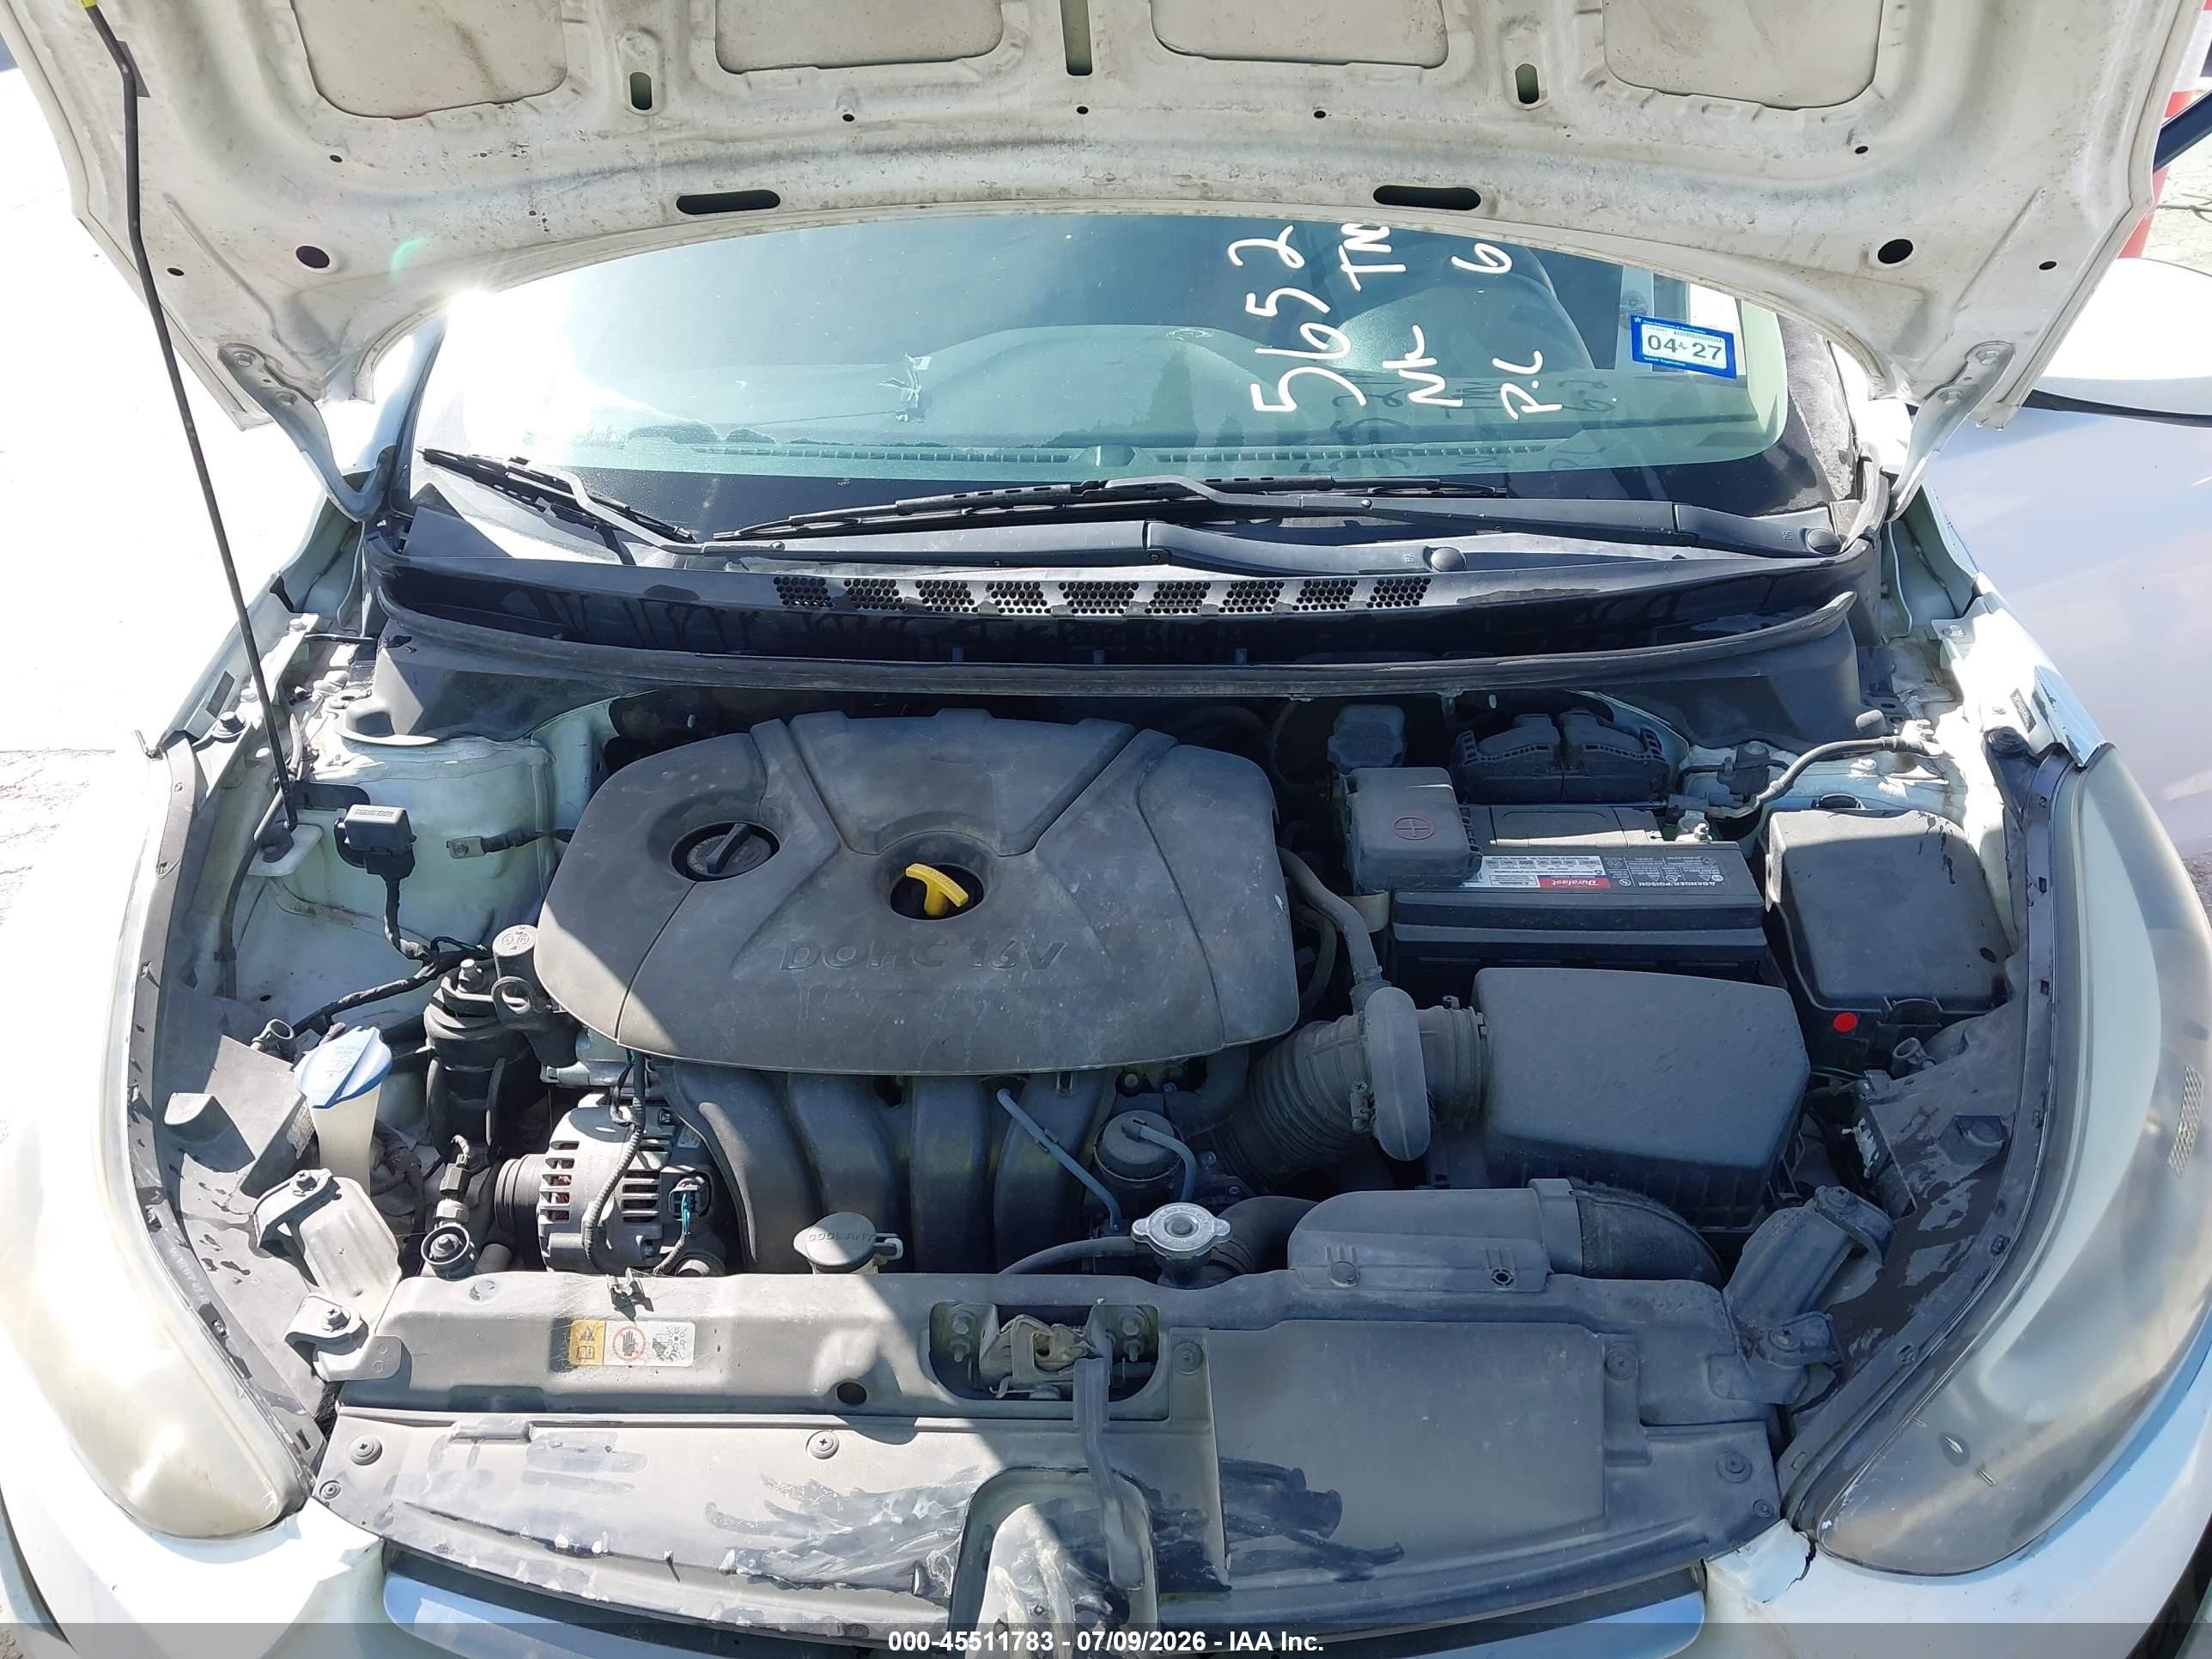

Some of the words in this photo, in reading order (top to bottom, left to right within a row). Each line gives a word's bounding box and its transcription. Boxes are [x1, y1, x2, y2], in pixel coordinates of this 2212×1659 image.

[1227, 224, 1367, 413] 5652
[1647, 334, 1679, 354] 04
[1692, 342, 1723, 361] 27
[780, 939, 947, 970] DOHC
[971, 939, 1068, 970] 16V
[809, 1230, 876, 1243] COOLANT
